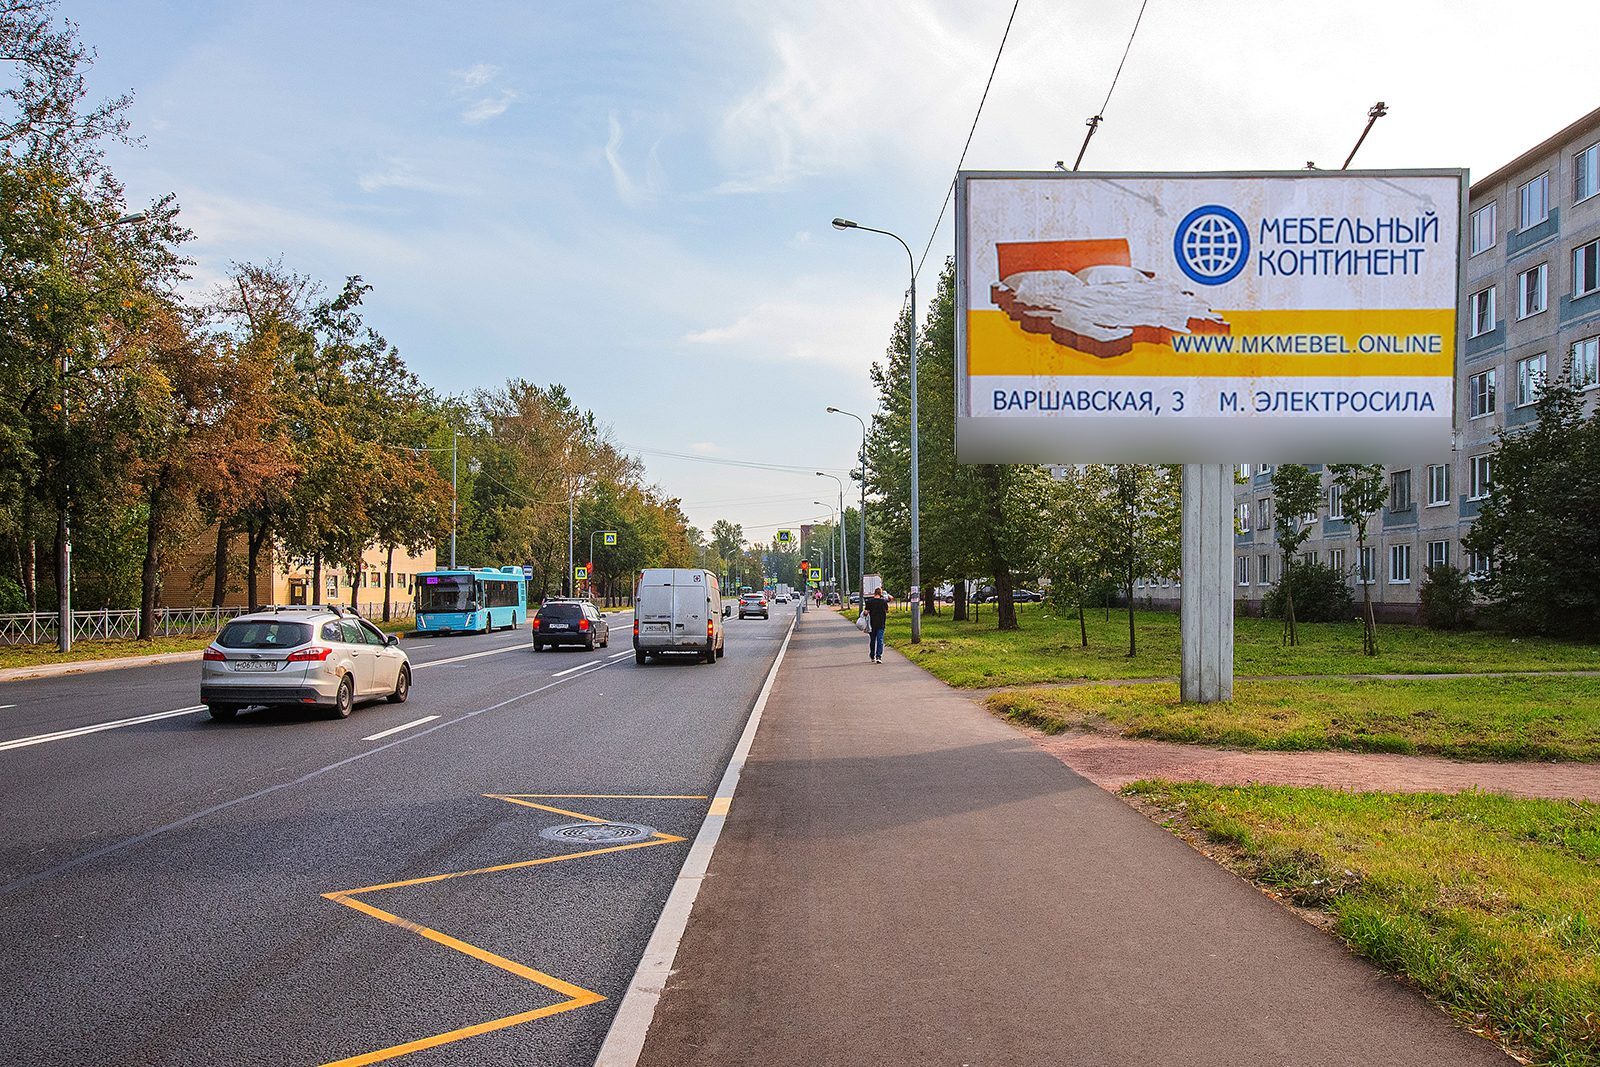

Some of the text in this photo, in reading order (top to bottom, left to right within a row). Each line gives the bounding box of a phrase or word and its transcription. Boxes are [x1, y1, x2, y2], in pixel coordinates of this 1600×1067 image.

[1260, 210, 1440, 245] МЕБЕЛЬНЫЙ
[1259, 248, 1426, 277] КОНТИНЕНТ
[1172, 335, 1441, 355] WWW.MKMEBEL.ONLINE
[993, 390, 1436, 416] ВАРШАВСКАЯ, 3 М. ЭЛЕКТРОСИЛА
